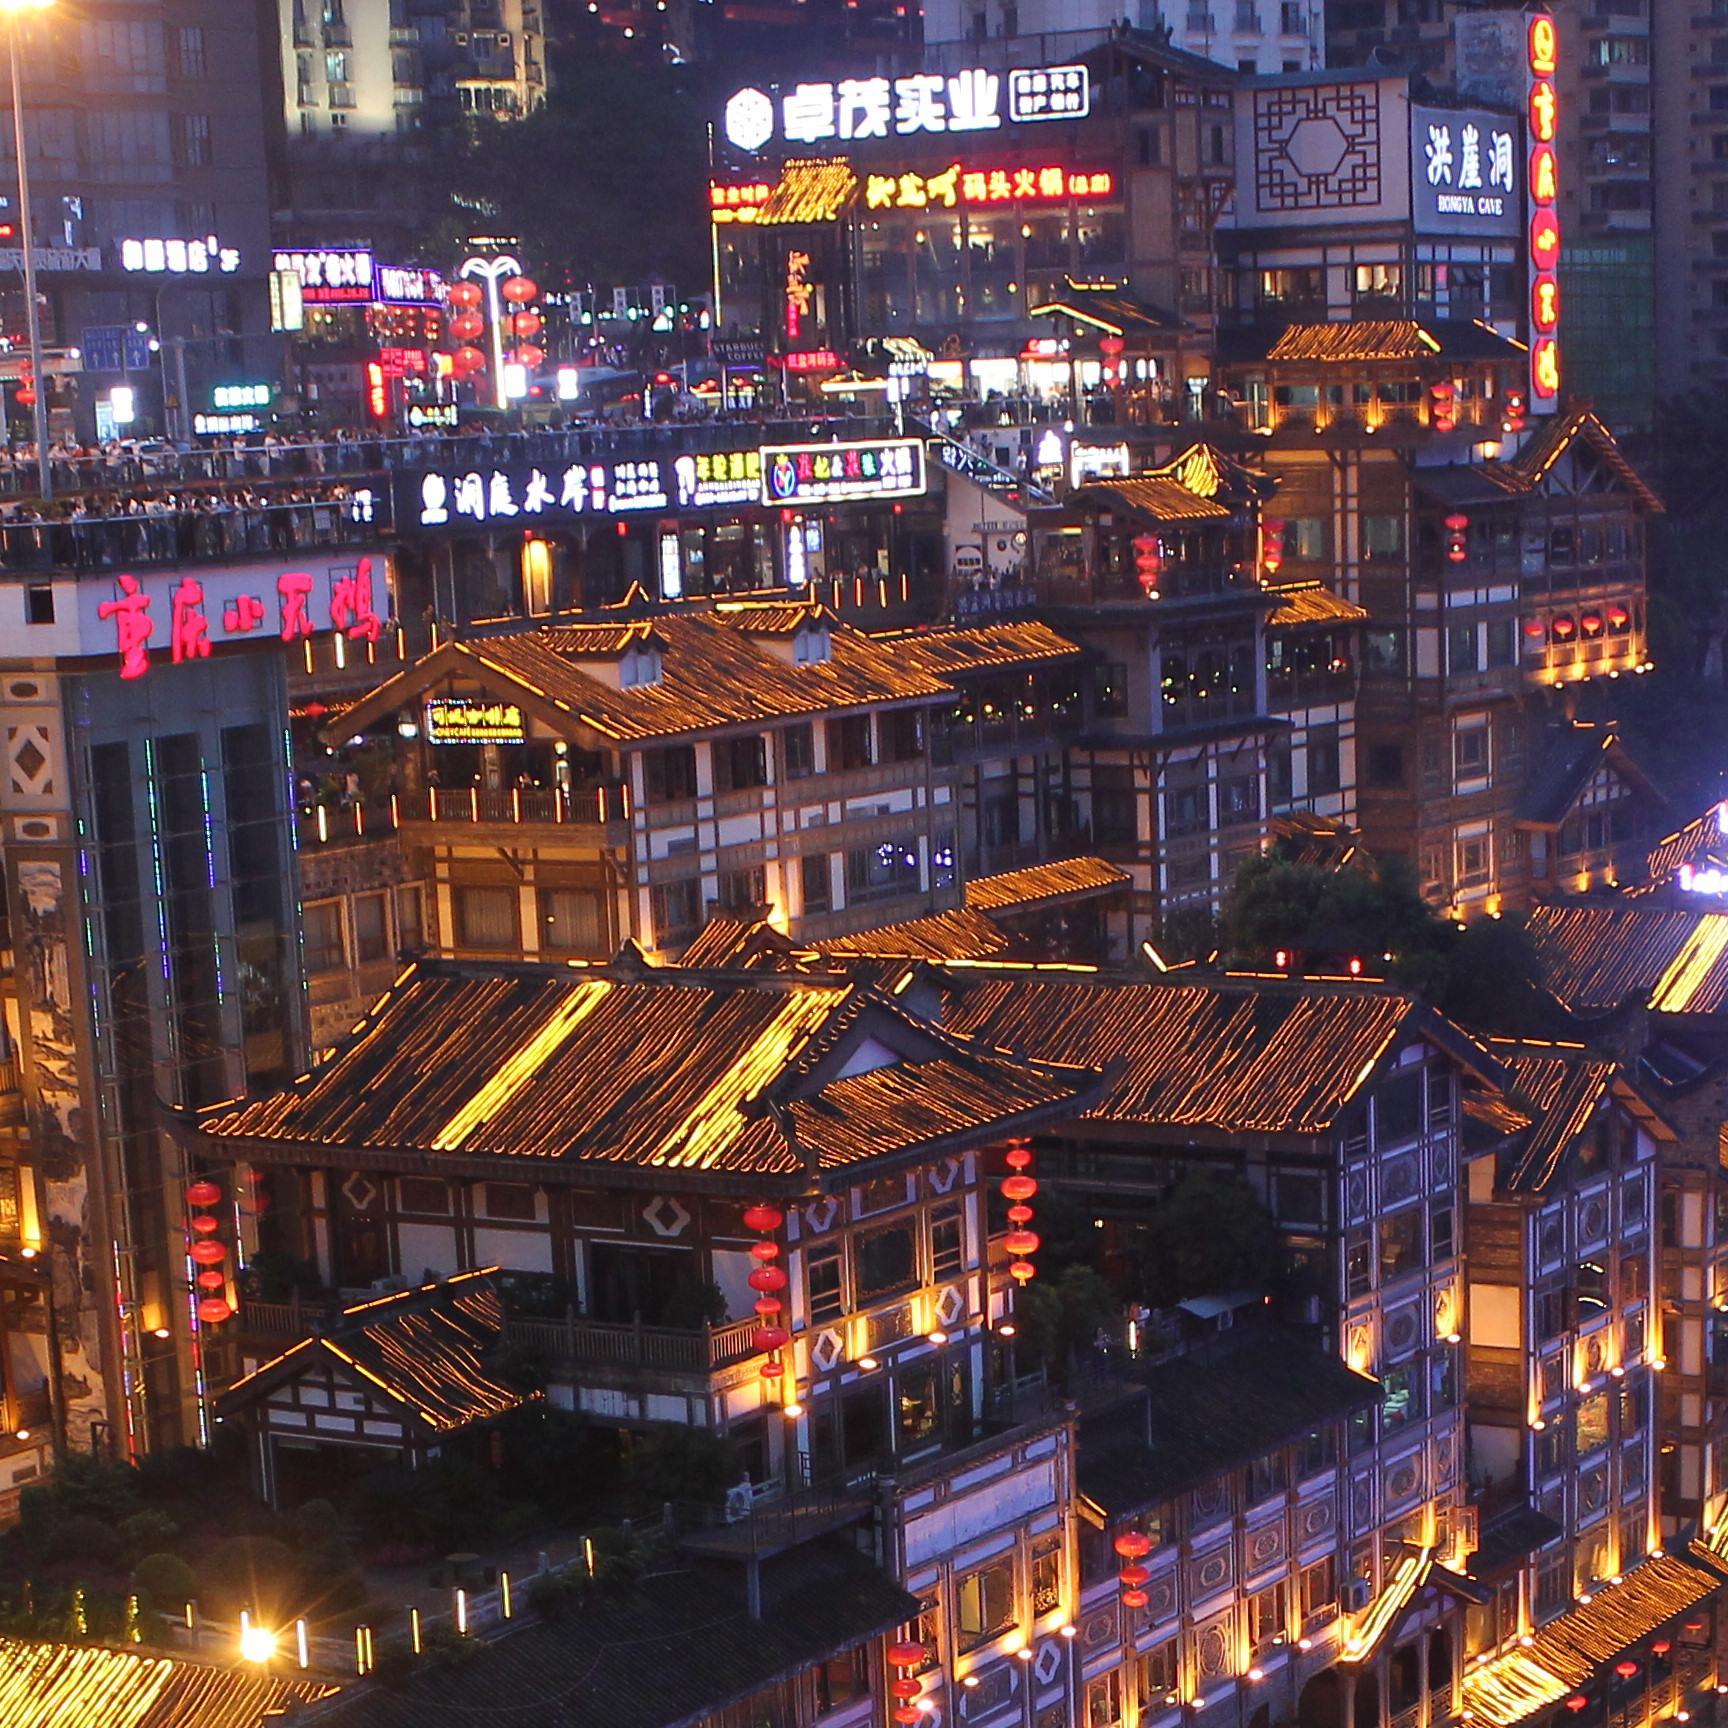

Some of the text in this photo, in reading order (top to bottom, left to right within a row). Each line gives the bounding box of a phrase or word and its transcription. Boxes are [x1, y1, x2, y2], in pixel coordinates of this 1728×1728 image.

[783, 68, 1001, 142] 卓茂实业
[1425, 123, 1513, 192] 洪崖洞
[1438, 194, 1503, 215] HONGYA CAVE
[454, 463, 589, 522] 洞庭水岸
[98, 557, 381, 680] 重庆小天鹅
